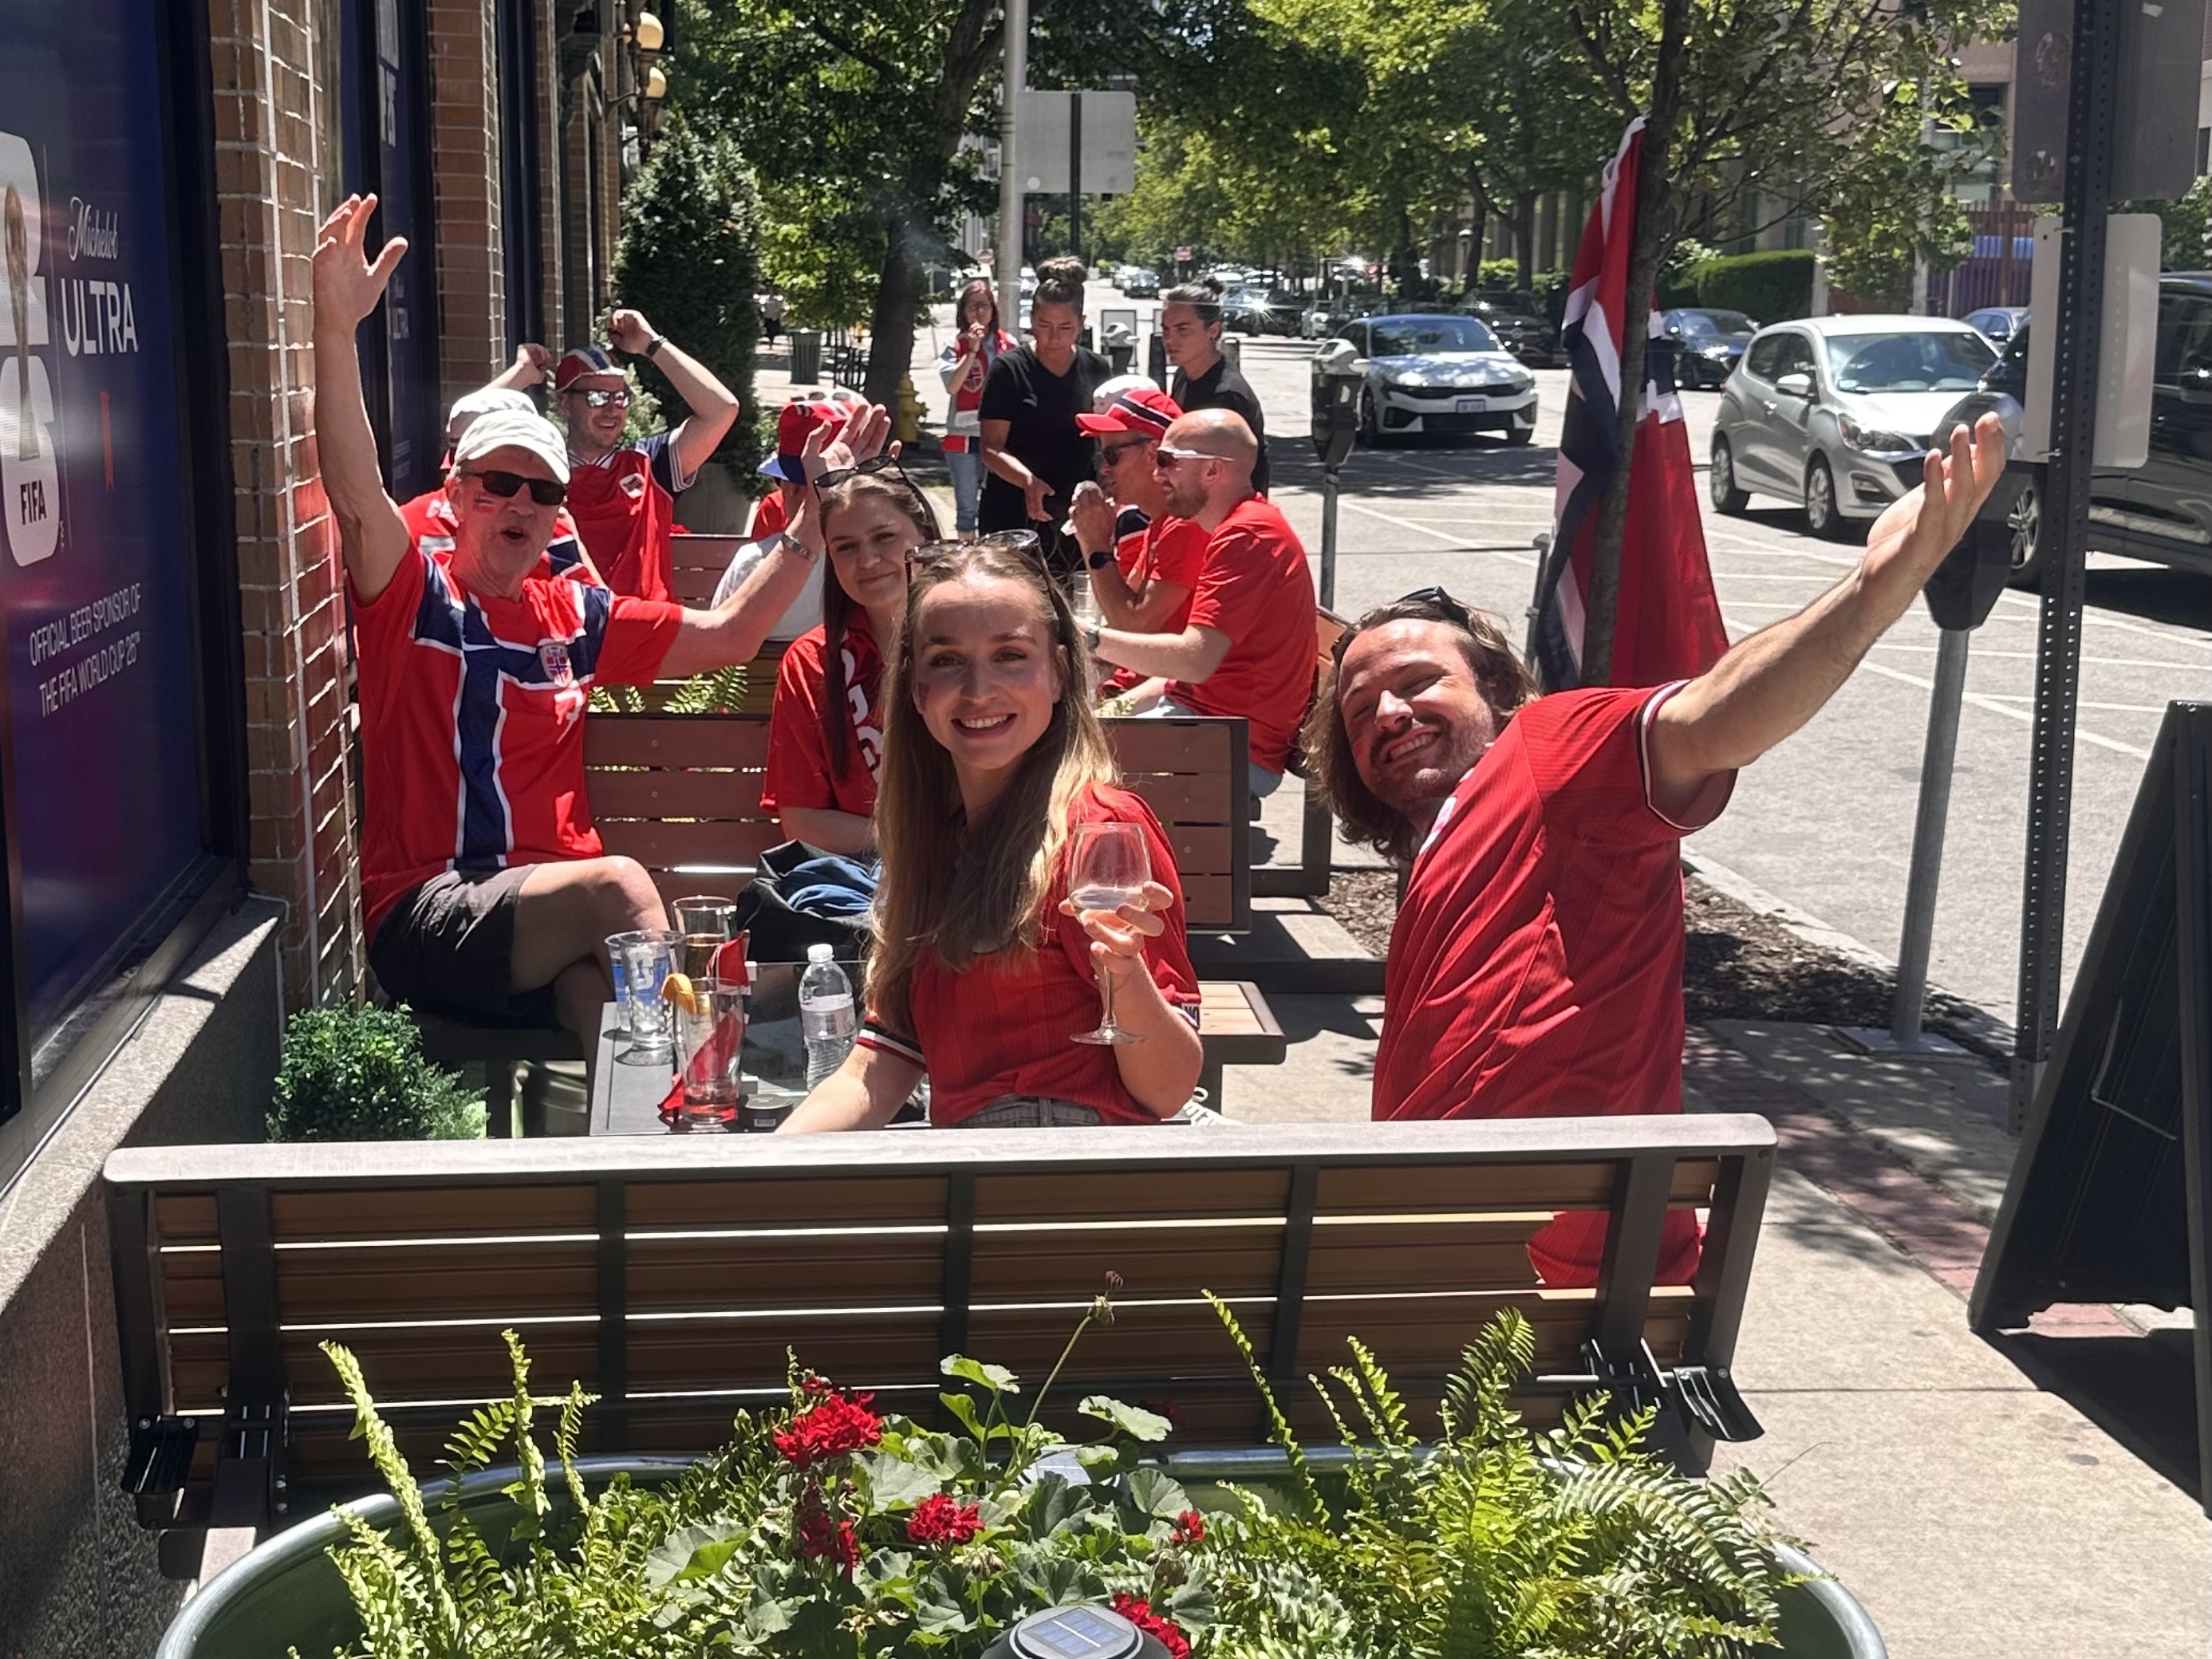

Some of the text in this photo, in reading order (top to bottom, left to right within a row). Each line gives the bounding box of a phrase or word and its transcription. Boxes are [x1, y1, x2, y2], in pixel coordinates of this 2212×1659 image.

[61, 278, 138, 357] ULTRA
[20, 479, 47, 526] FIFA
[30, 582, 141, 667] OFFICIAL BEER SPONSOR OF
[39, 676, 58, 718] THE
[58, 666, 79, 707] FIFA
[77, 649, 108, 694] WORLD
[108, 639, 125, 676] CUP
